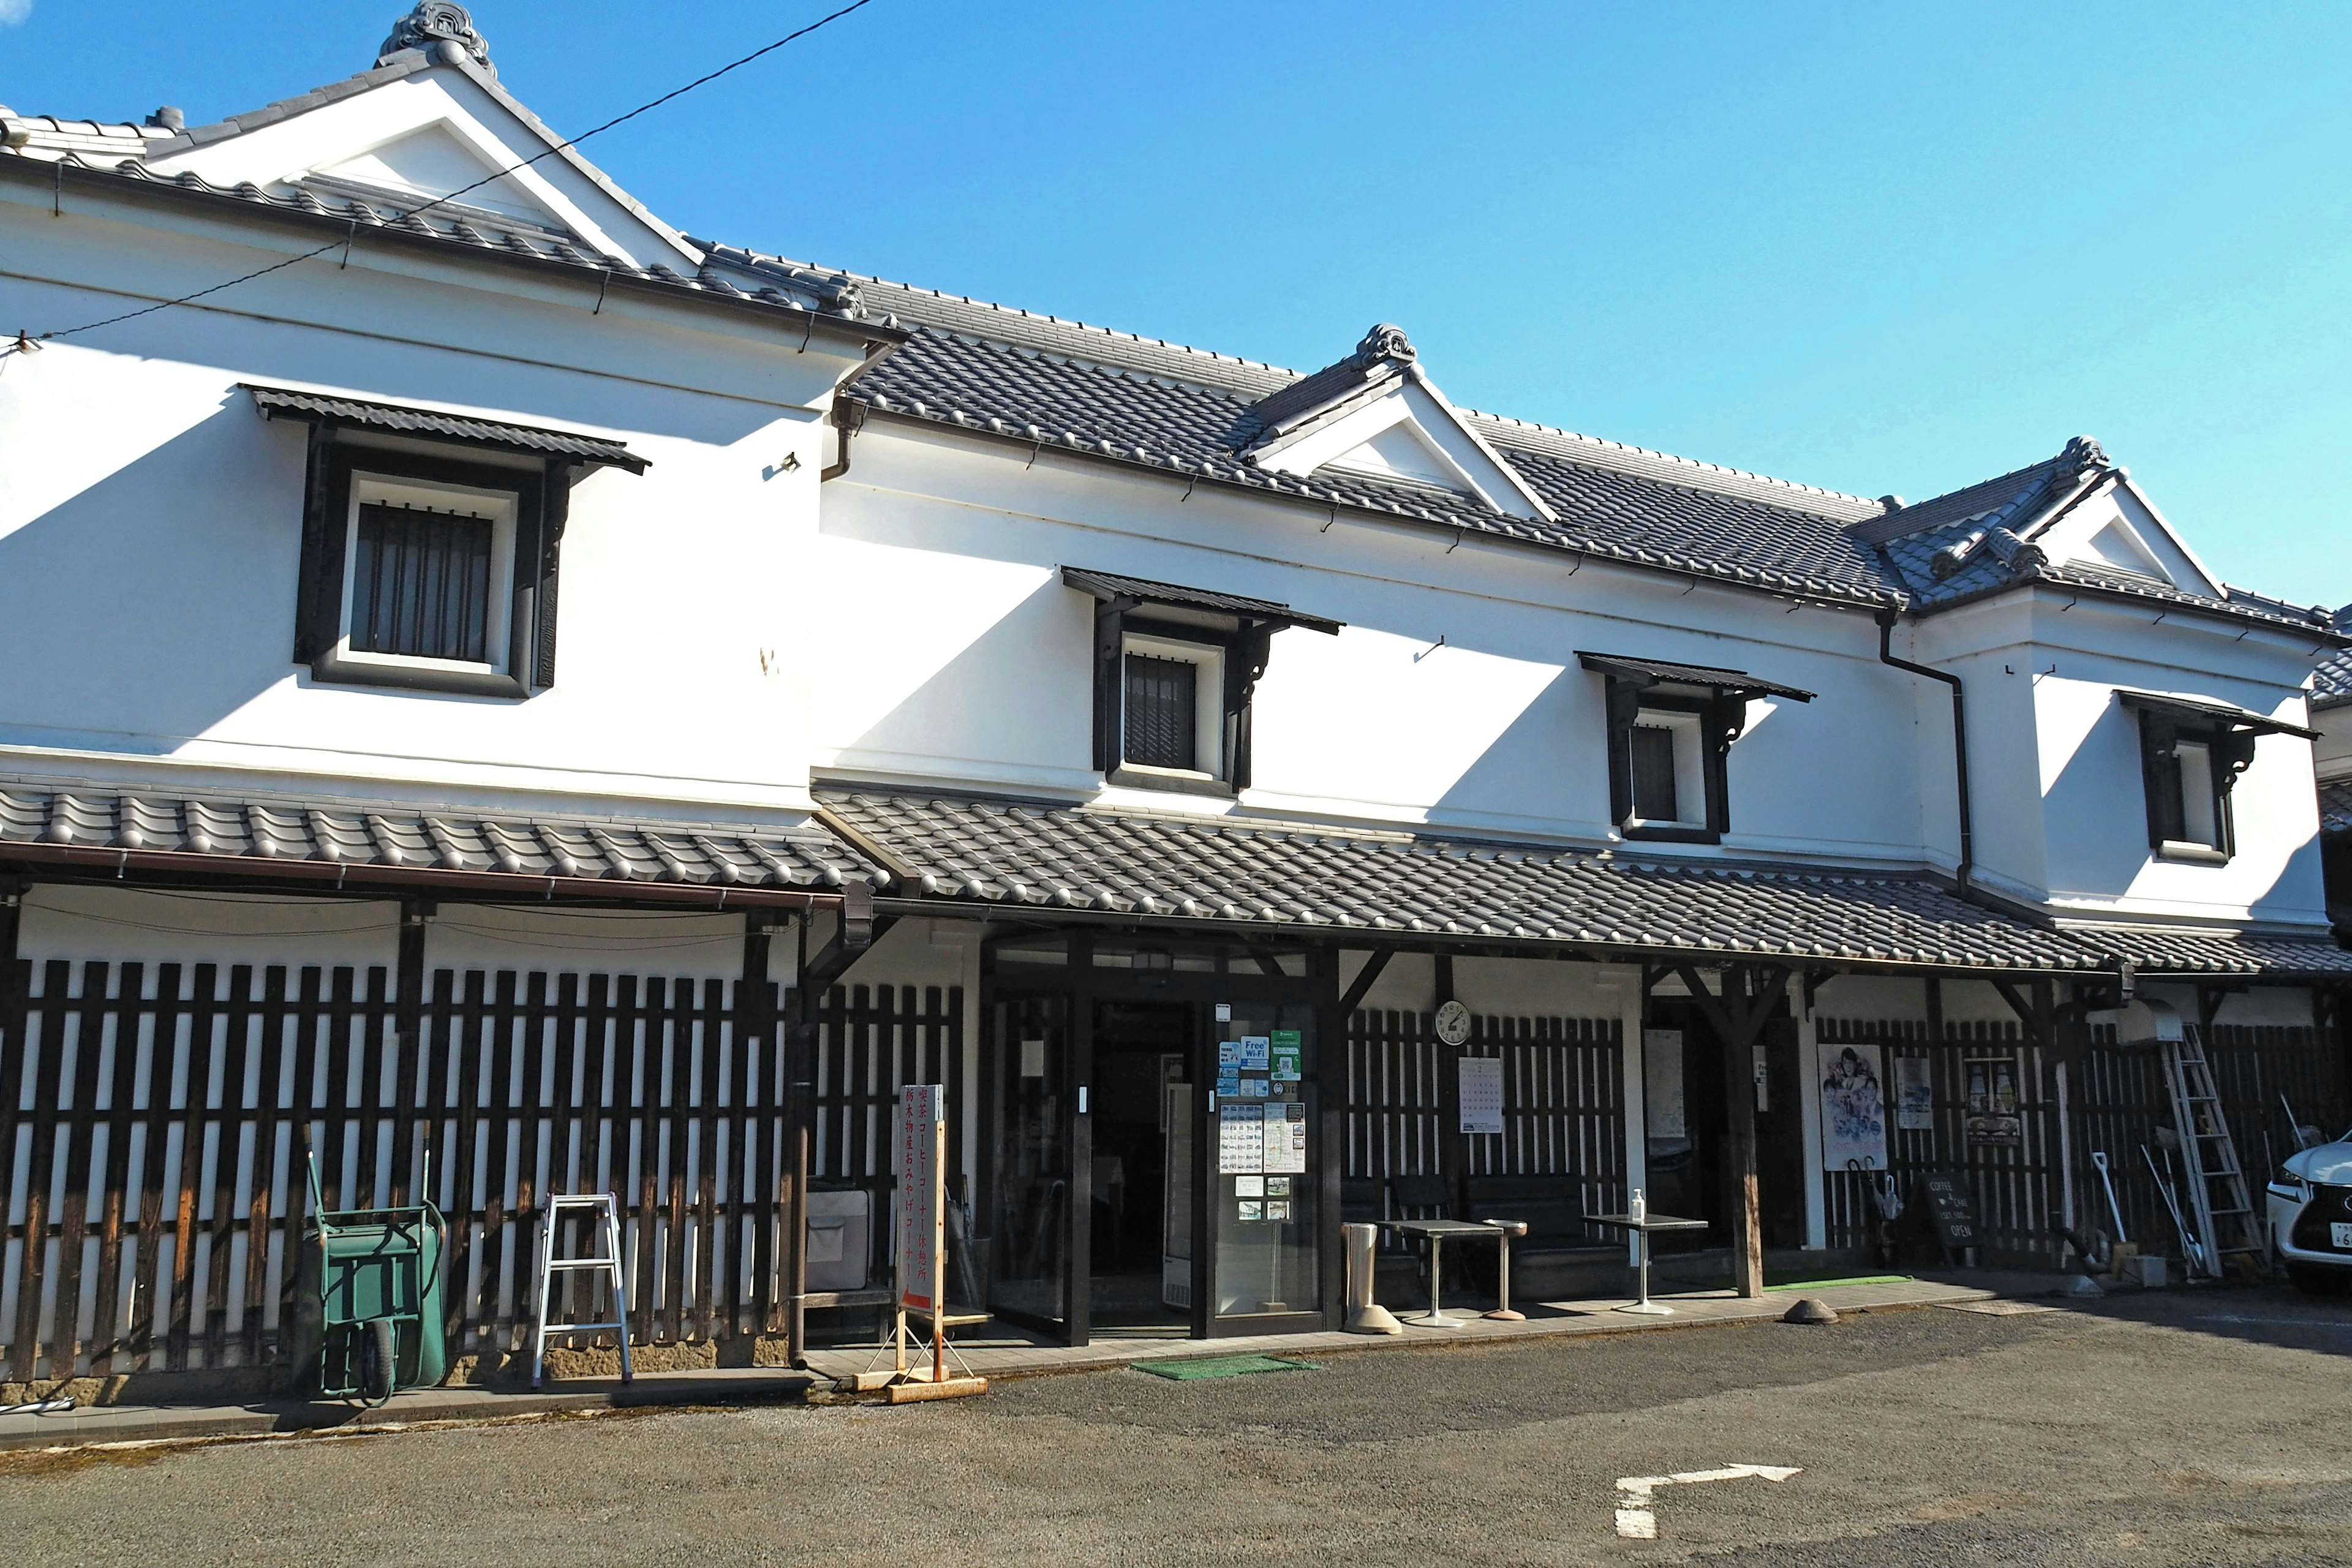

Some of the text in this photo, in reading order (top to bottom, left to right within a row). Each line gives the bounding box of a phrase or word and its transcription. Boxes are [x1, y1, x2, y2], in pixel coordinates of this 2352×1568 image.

[905, 1088, 914, 1276] 栃木物産おみやげコーナー
[918, 1088, 927, 1281] 喫茶コーヒーコーナー休憩所
[1930, 1182, 1952, 1191] COFFEE
[1951, 1225, 1972, 1237] OPEN
